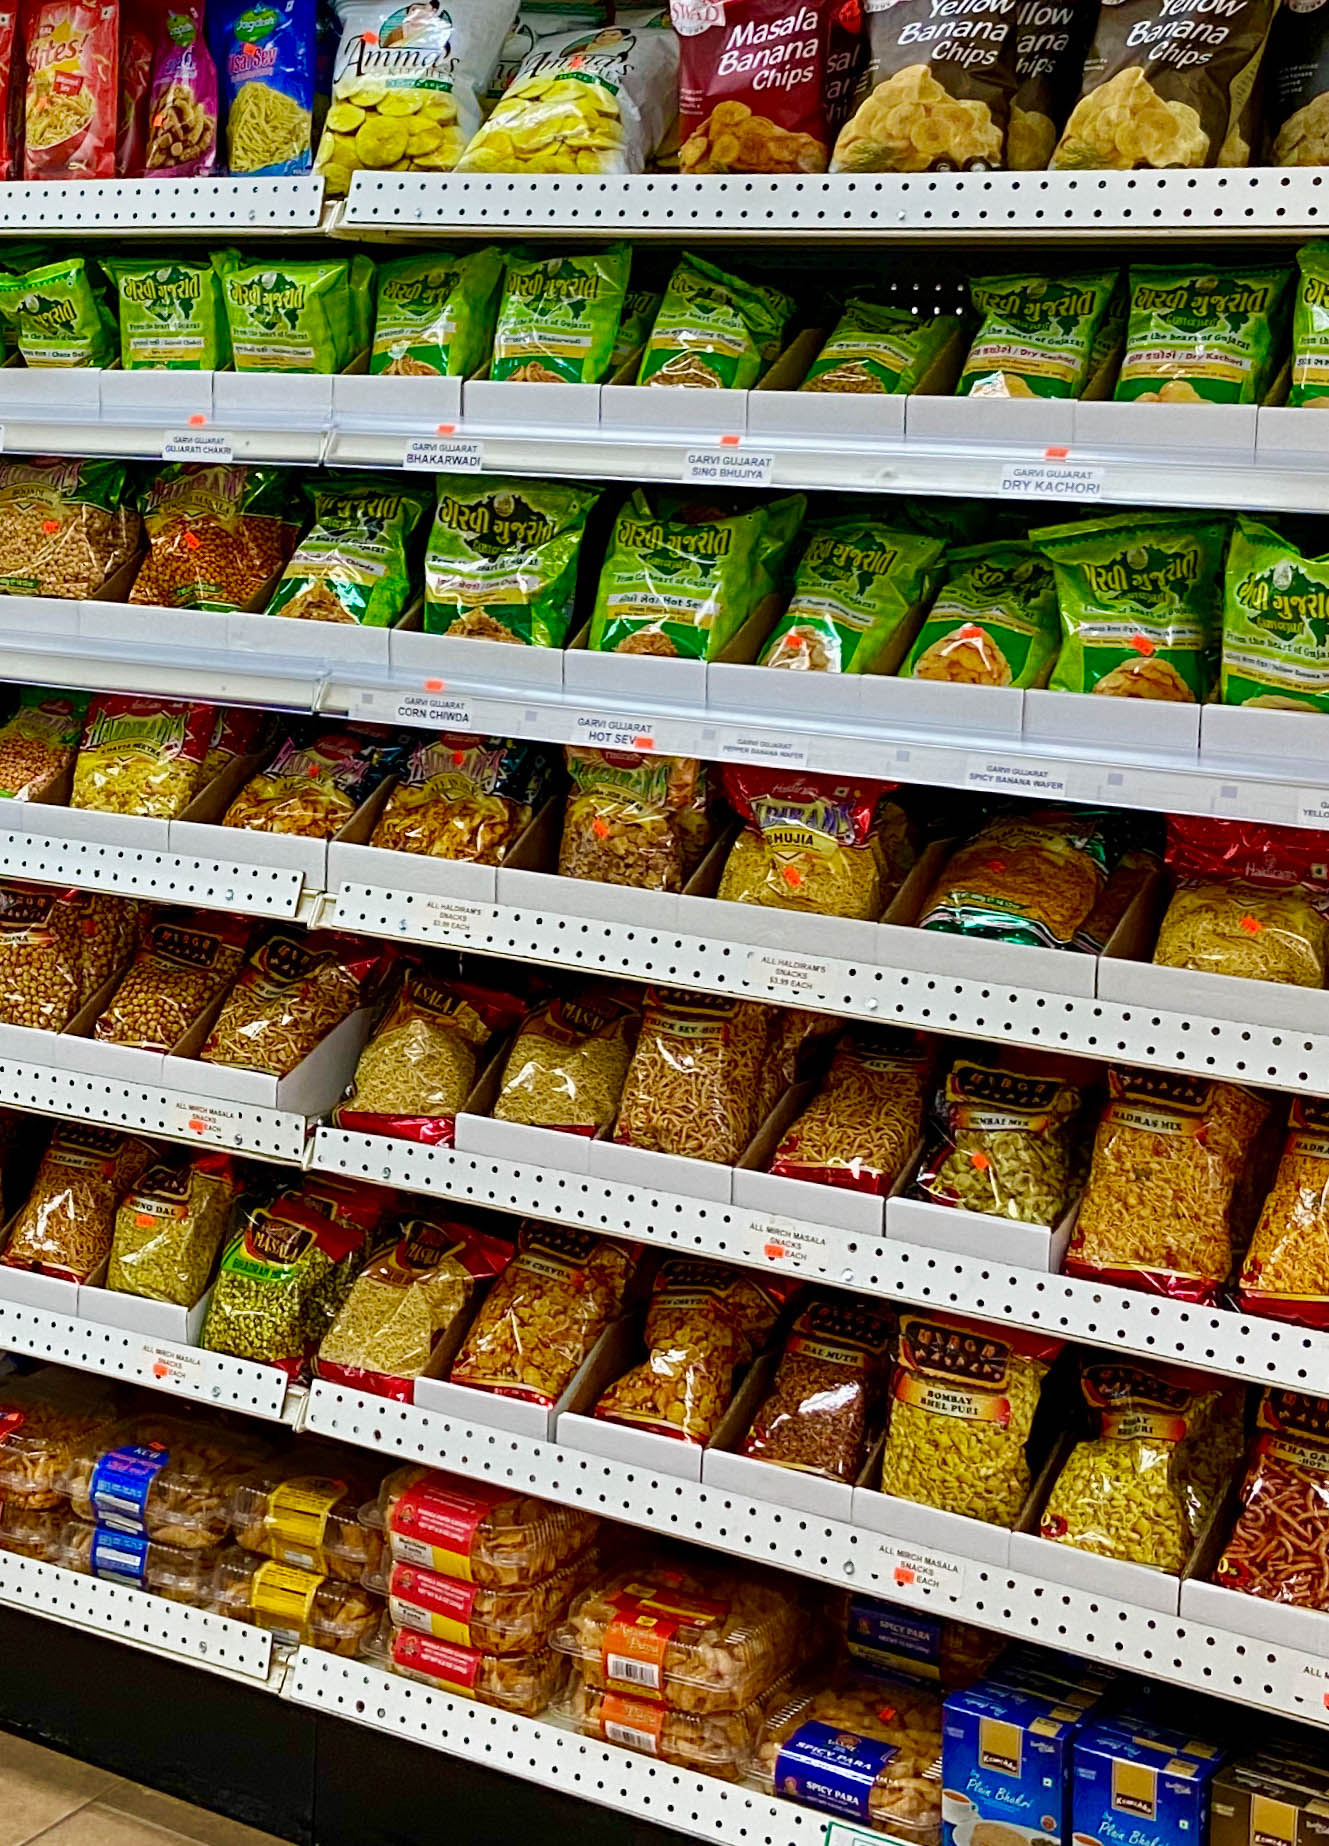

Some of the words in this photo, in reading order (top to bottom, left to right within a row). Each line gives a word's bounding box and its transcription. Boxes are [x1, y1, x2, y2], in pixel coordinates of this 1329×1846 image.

[725, 7, 818, 50] Masala
[898, 20, 1009, 46] Banana
[1126, 20, 1230, 47] Banana
[334, 35, 460, 85] Amma's
[718, 38, 818, 76] Banana
[931, 40, 998, 66] Chips
[1149, 41, 1213, 69] Chips
[752, 65, 815, 91] Chips
[1020, 348, 1038, 359] Dry
[412, 443, 438, 451] GARVI
[439, 443, 478, 453] GUJARAT
[406, 453, 481, 467] BHAKARWADI
[687, 455, 720, 466] GARVI
[722, 456, 772, 467] GUJARAT
[691, 466, 718, 476] SING
[720, 469, 763, 480] BHUJIYA
[1013, 468, 1044, 477] GARVI
[1046, 469, 1093, 480] GUJARAT
[1002, 479, 1031, 492] DRY
[1034, 481, 1100, 495] KACHORI
[404, 697, 428, 706] GARVI
[429, 698, 465, 710] GUJARAT
[397, 706, 427, 718] CORN
[429, 709, 469, 723] CHIWDA
[577, 718, 606, 729] GARVI
[608, 720, 652, 733] GUJARAT
[589, 730, 613, 742] HOT
[615, 732, 638, 745] SEV
[995, 776, 1032, 787] BANANA
[1033, 780, 1064, 790] WAFER
[761, 957, 777, 965] ALL
[778, 959, 826, 974] HALDIRAM'S
[776, 968, 808, 979] SNACKS
[791, 980, 813, 990] EACH
[1162, 1118, 1183, 1131] MIX
[750, 1223, 764, 1232] ALL
[766, 1226, 792, 1238] MIRCH
[793, 1231, 826, 1245] MASALA
[785, 1250, 807, 1261] EACH
[927, 1389, 973, 1405] BOMBAY
[921, 1397, 948, 1411] BHEL
[951, 1403, 978, 1416] PURI
[878, 1545, 893, 1555] ALL
[897, 1550, 923, 1562] MIRCH
[923, 1557, 959, 1573] MASALA
[900, 1561, 934, 1576] SNACKS
[916, 1576, 940, 1588] EACH
[1303, 1665, 1322, 1678] ALL
[795, 1741, 836, 1757] SPICY
[836, 1753, 872, 1770] PARA
[965, 1777, 994, 1793] Plain
[806, 1781, 833, 1796] SPICY
[834, 1790, 860, 1806] PARA
[1097, 1820, 1128, 1838] Plain
